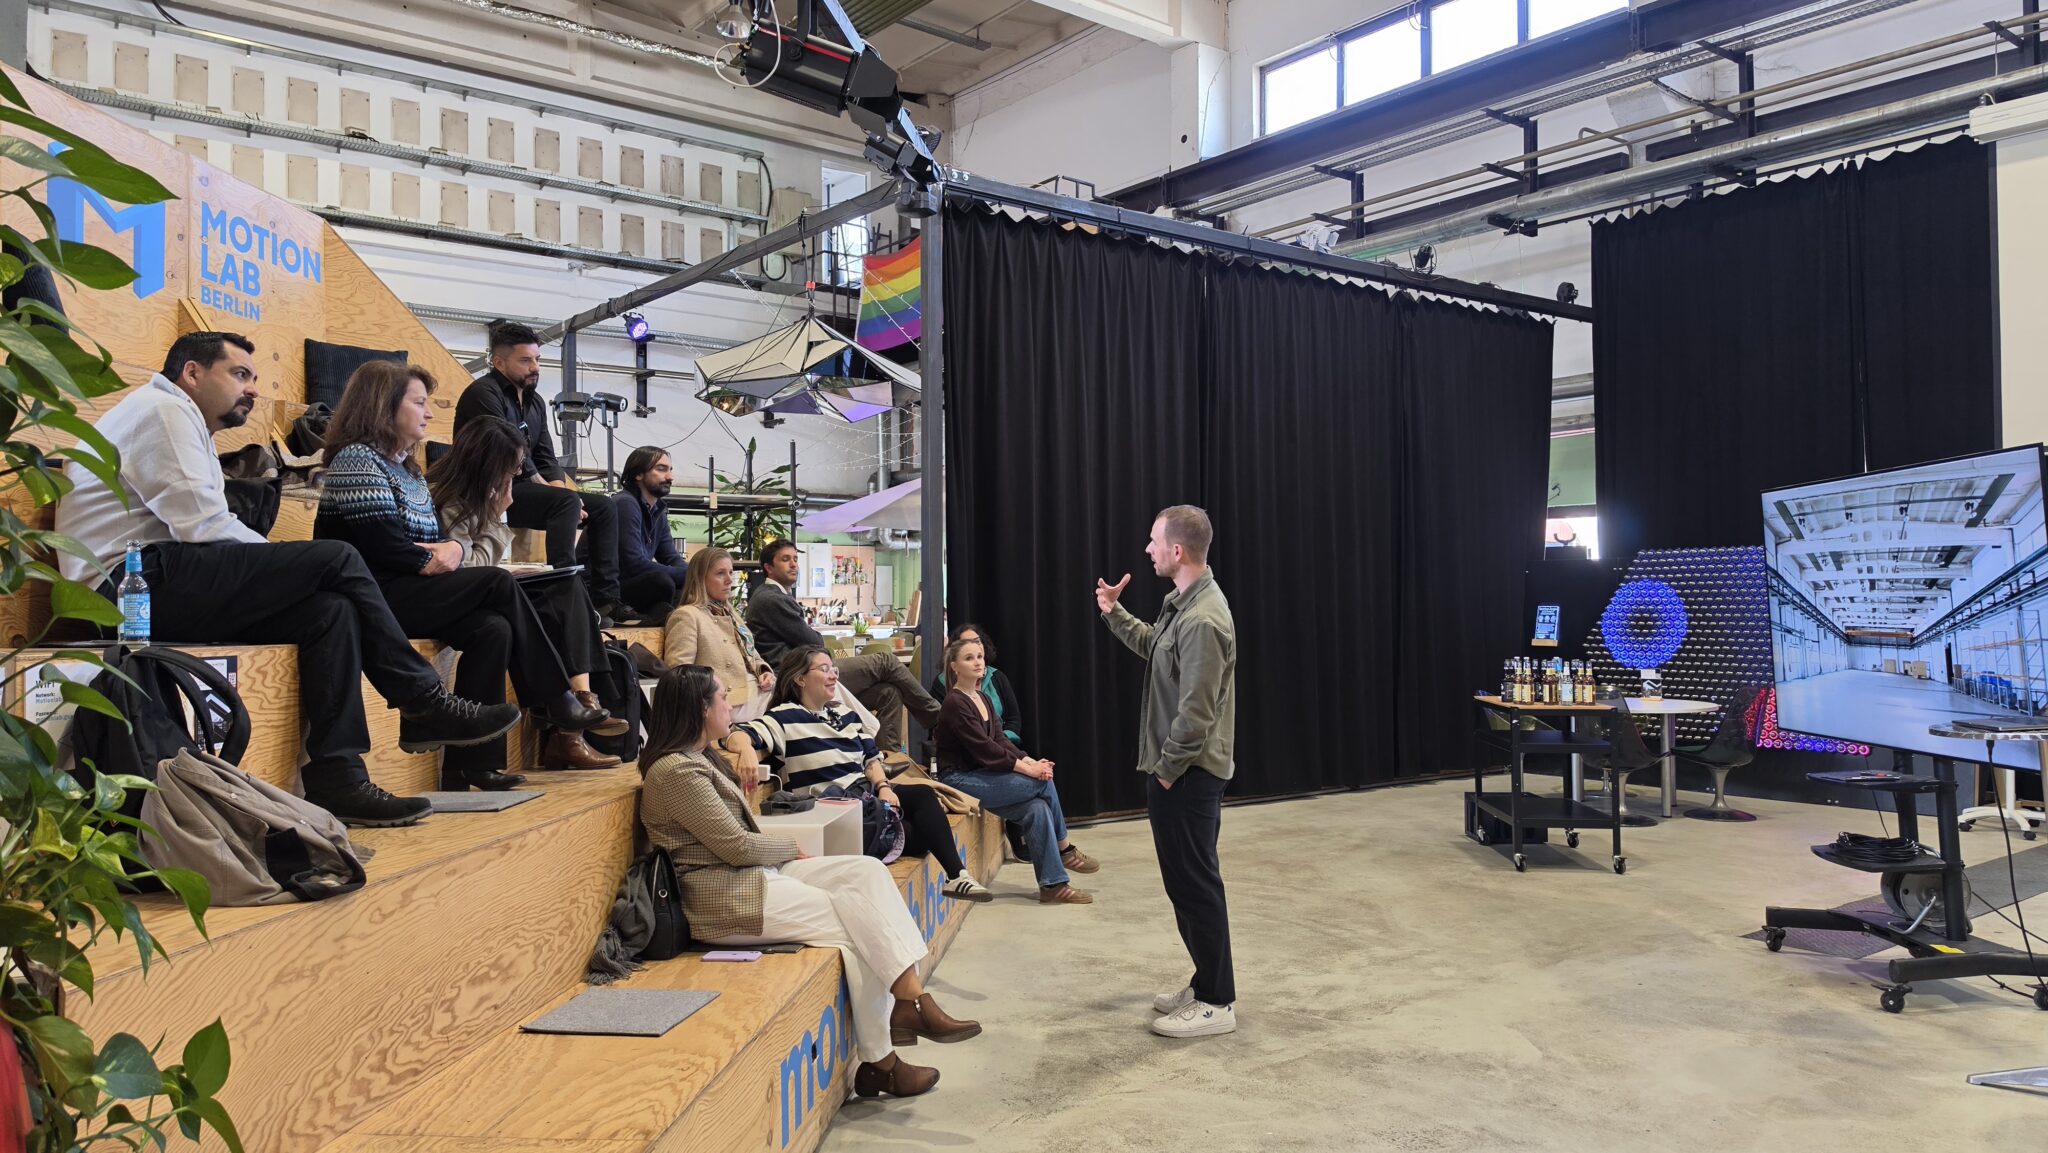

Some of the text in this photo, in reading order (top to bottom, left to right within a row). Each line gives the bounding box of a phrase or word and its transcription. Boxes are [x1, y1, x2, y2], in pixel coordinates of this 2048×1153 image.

[201, 201, 321, 283] MOTION
[201, 242, 261, 296] LAB
[201, 285, 260, 321] BERLIN
